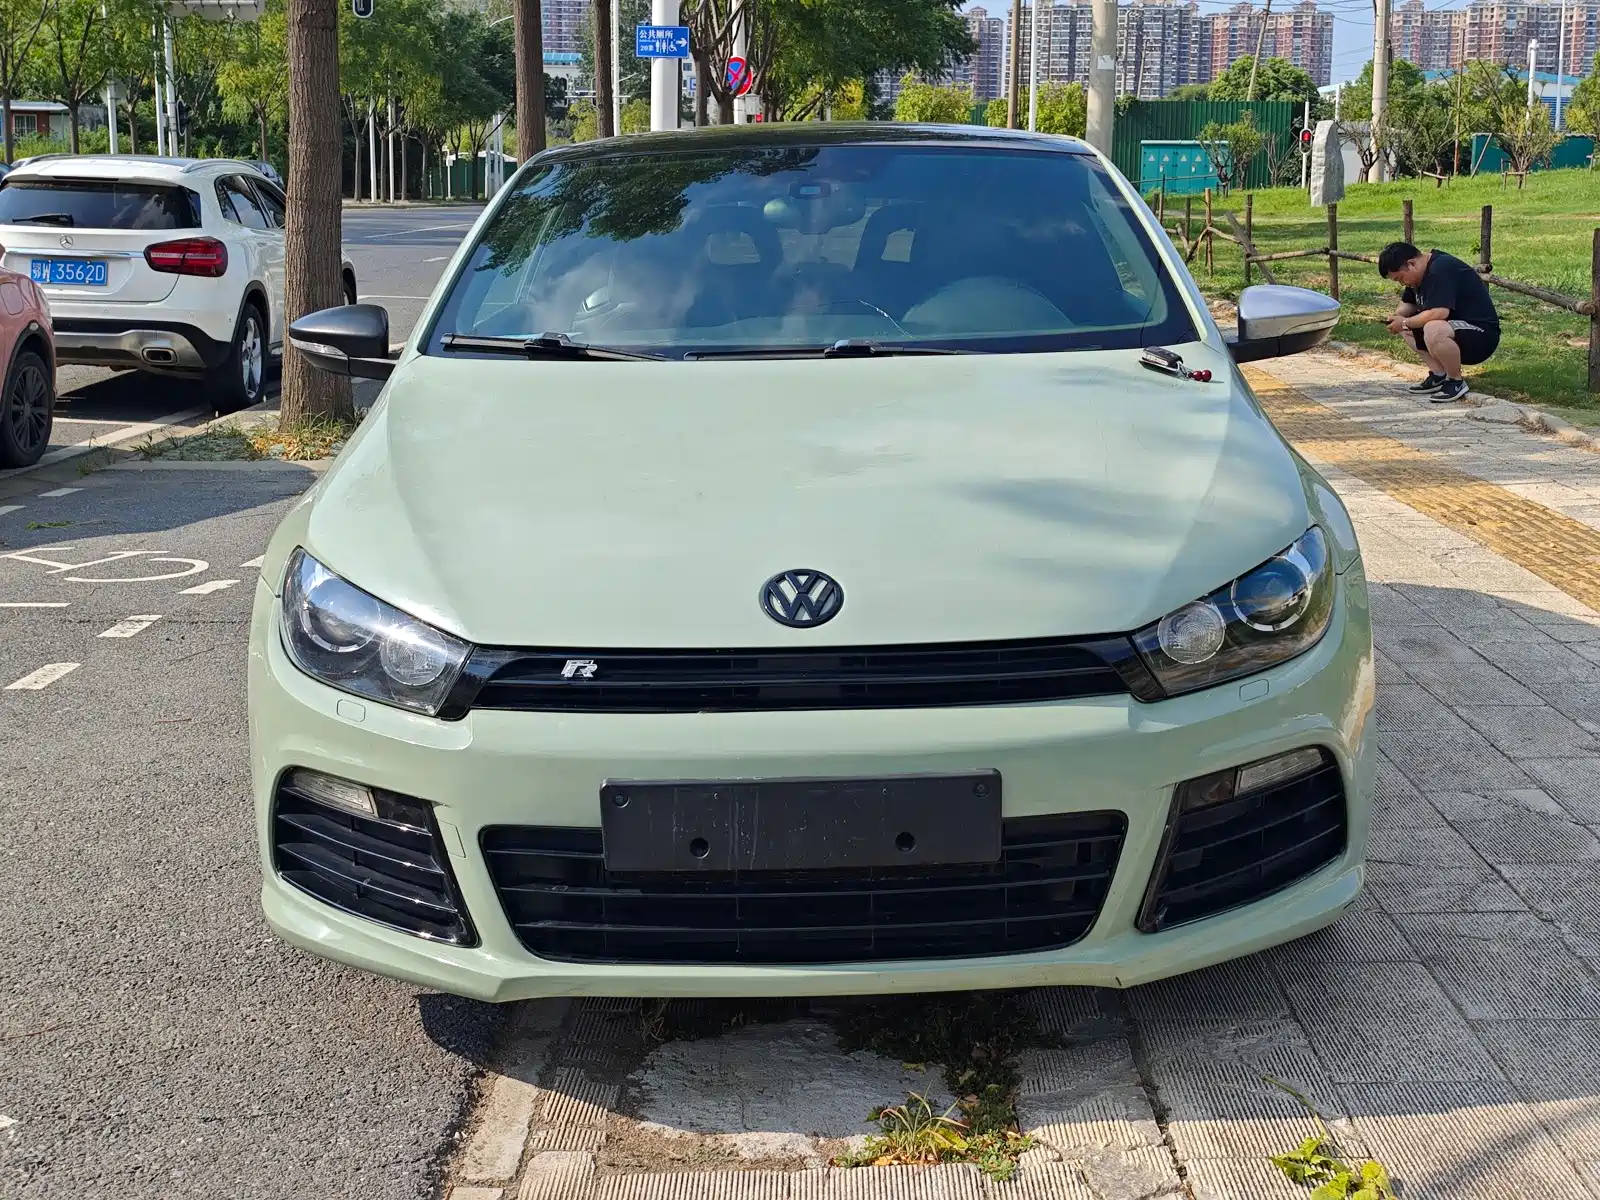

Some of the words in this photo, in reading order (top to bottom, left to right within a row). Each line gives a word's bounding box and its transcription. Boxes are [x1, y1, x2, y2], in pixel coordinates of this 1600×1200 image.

[639, 29, 674, 39] 公共厕所
[640, 44, 654, 52] 20米
[561, 659, 598, 678] R
